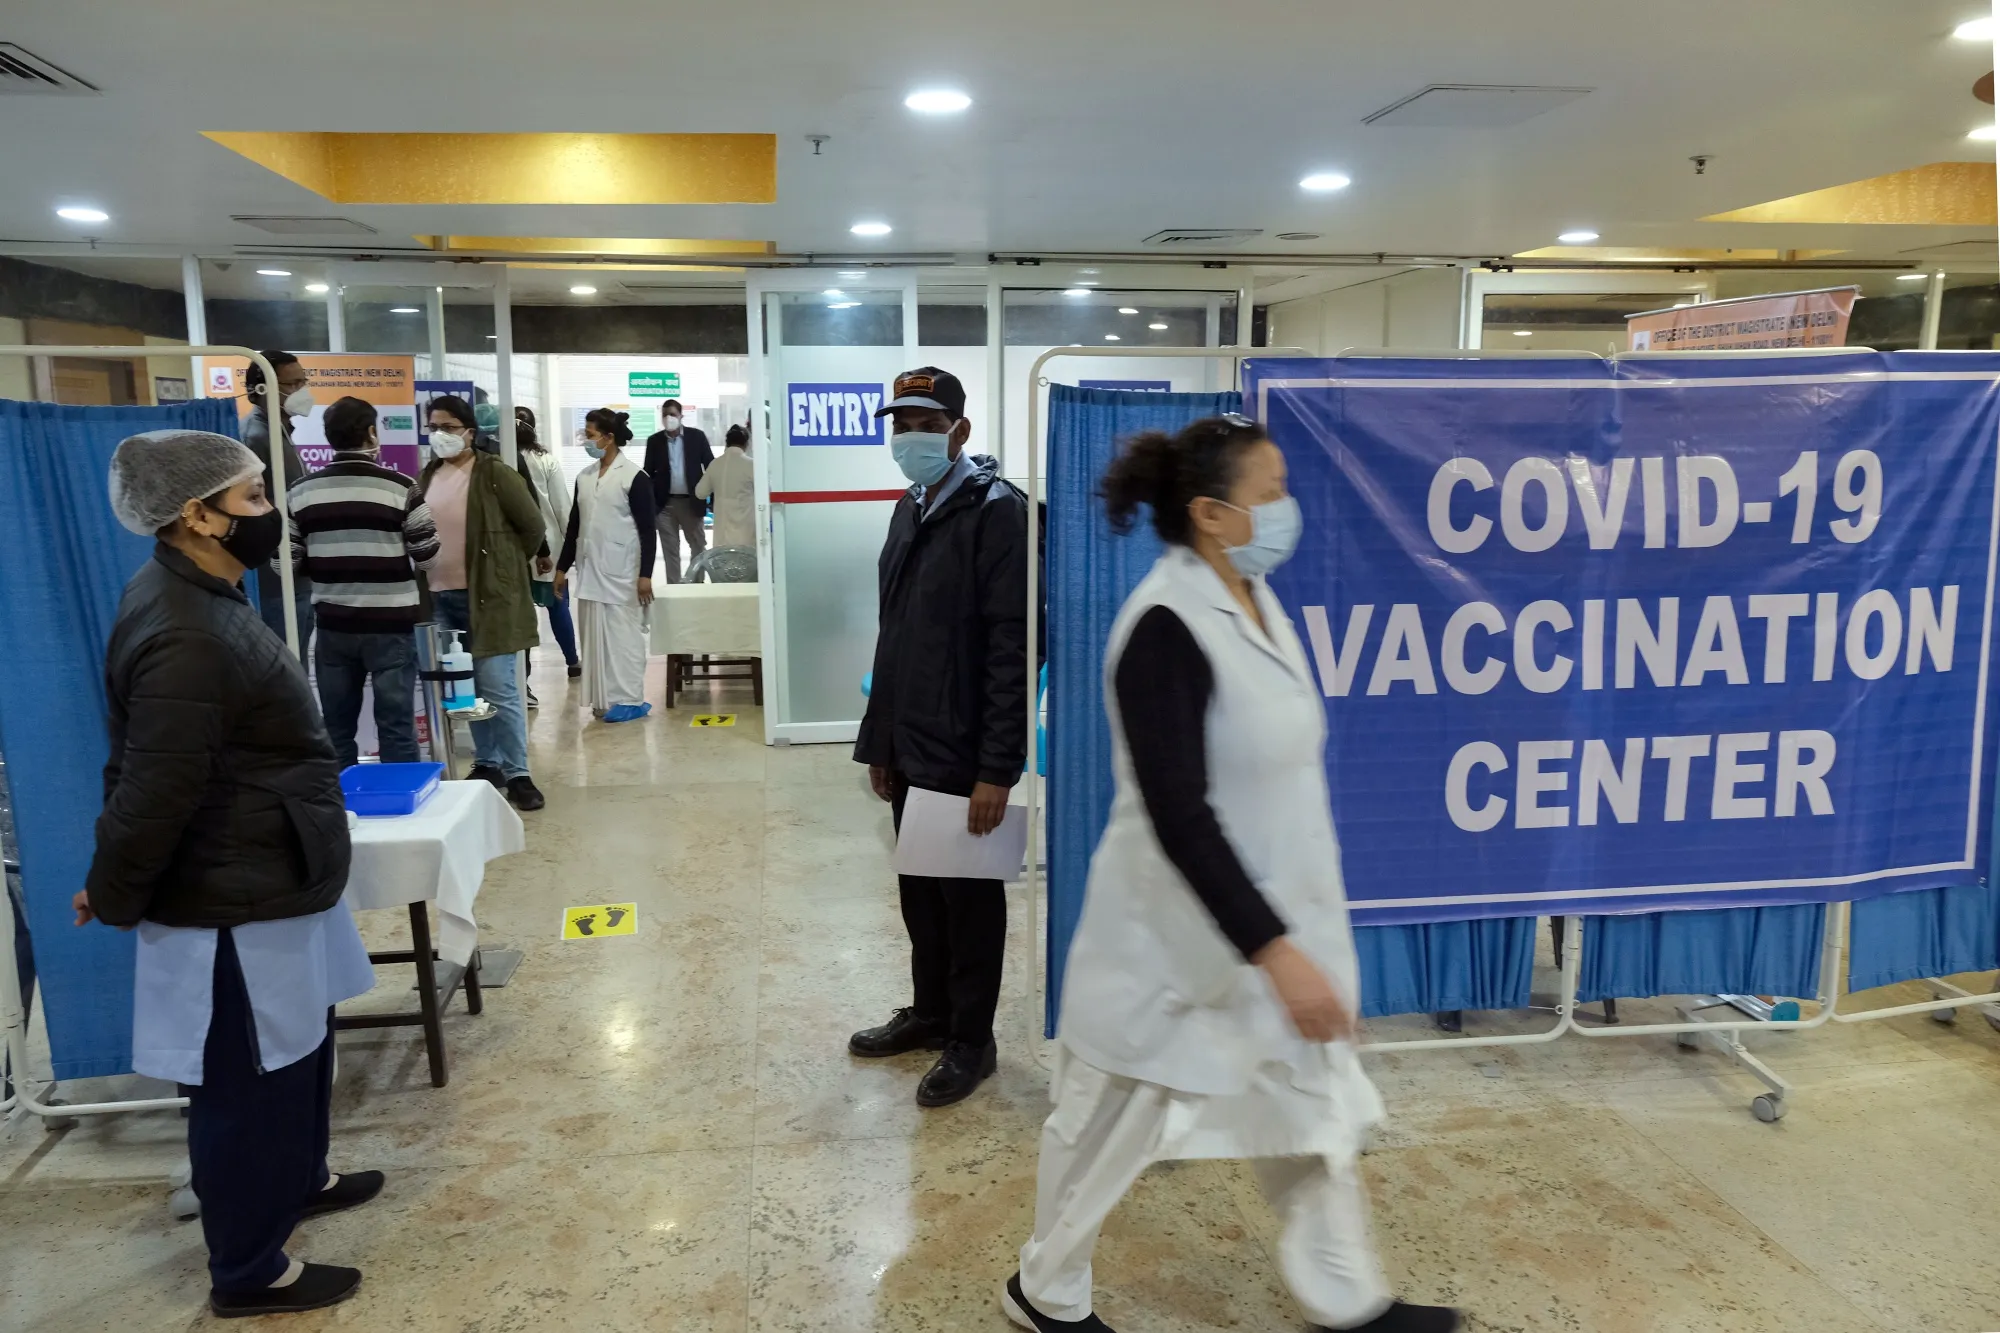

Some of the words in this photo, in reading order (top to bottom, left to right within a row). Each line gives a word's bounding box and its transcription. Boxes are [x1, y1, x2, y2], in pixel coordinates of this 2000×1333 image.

[1654, 328, 1677, 343] OFFICE
[1677, 327, 1687, 340] OF
[1688, 326, 1703, 339] THE
[1703, 322, 1736, 338] DISTRICT
[1737, 316, 1786, 335] MAGISTRATE
[320, 368, 363, 377] MAGISTRATE
[791, 392, 881, 437] ENTRY
[1426, 449, 1883, 554] COVID-19
[1303, 585, 1960, 698] VACCINATION
[1445, 730, 1837, 832] CENTER
